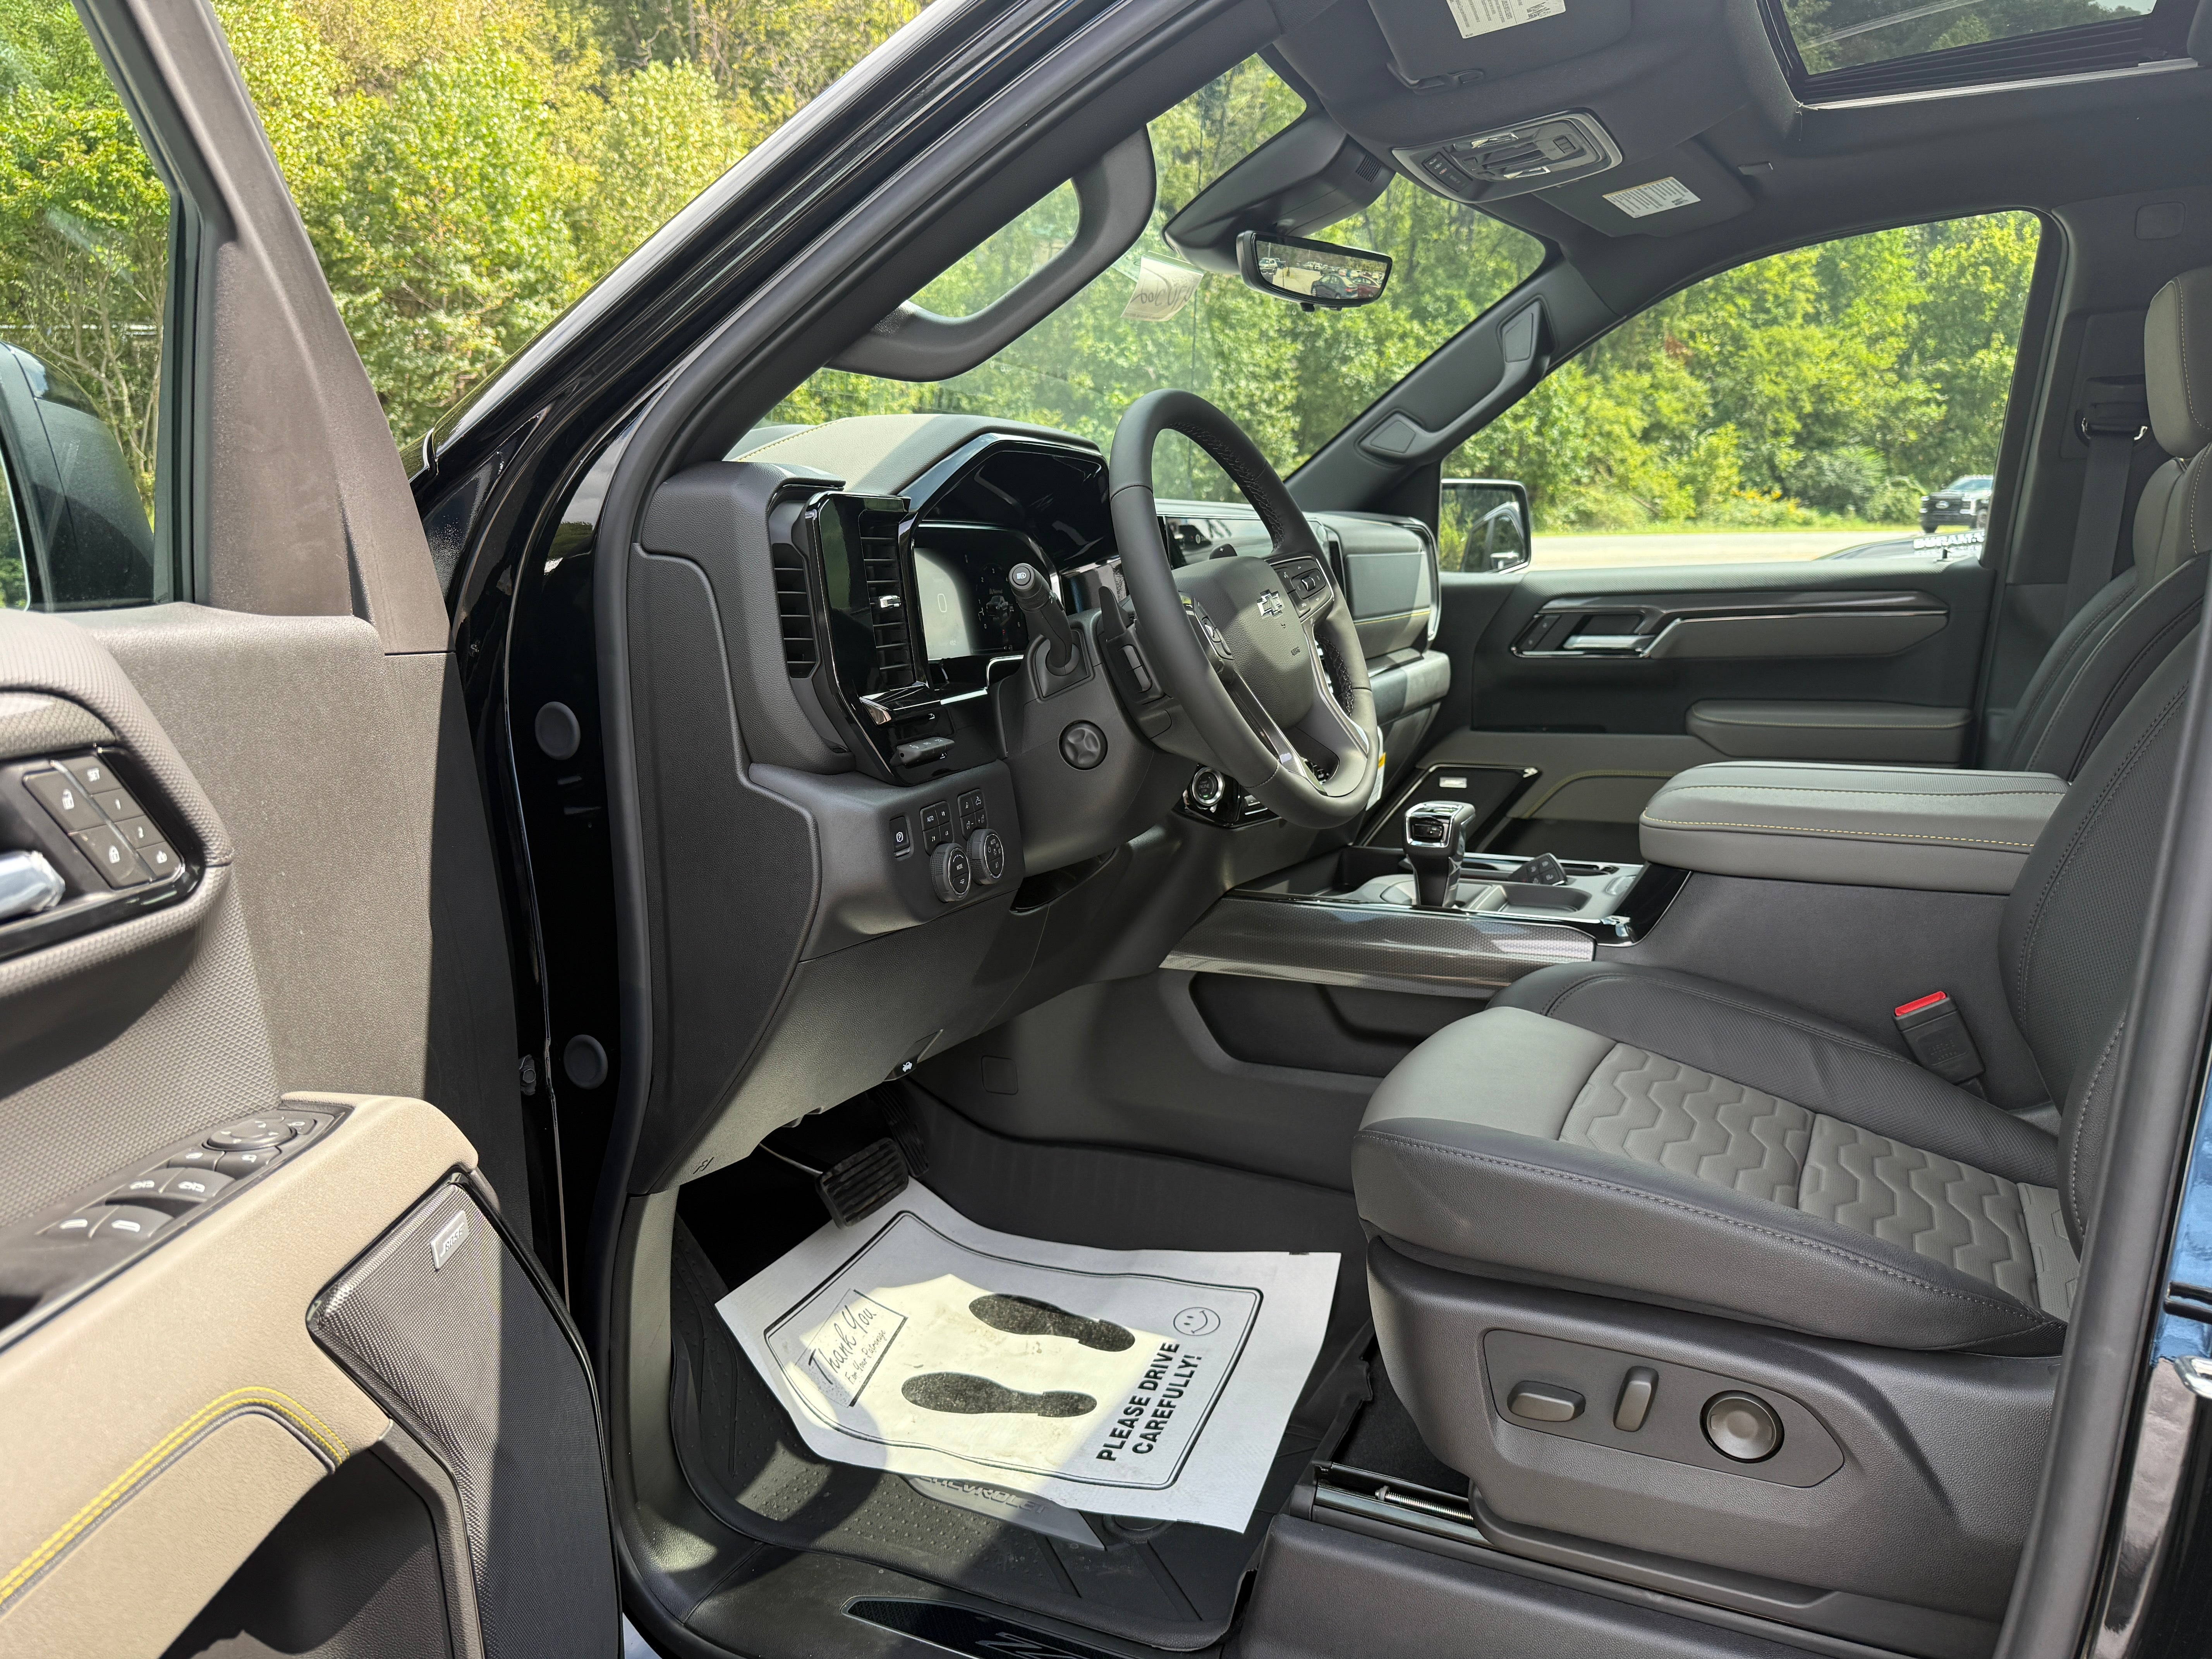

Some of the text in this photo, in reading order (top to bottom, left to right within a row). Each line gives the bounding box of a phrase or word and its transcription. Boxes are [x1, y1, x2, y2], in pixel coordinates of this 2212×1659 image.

[937, 593, 947, 613] 0
[808, 1305, 877, 1384] Thank You
[845, 1372, 857, 1385] For
[861, 1329, 887, 1358] Patronage
[1095, 1342, 1180, 1462] PLEASE DRIVE
[1132, 1354, 1202, 1454] CAREFULLY!
